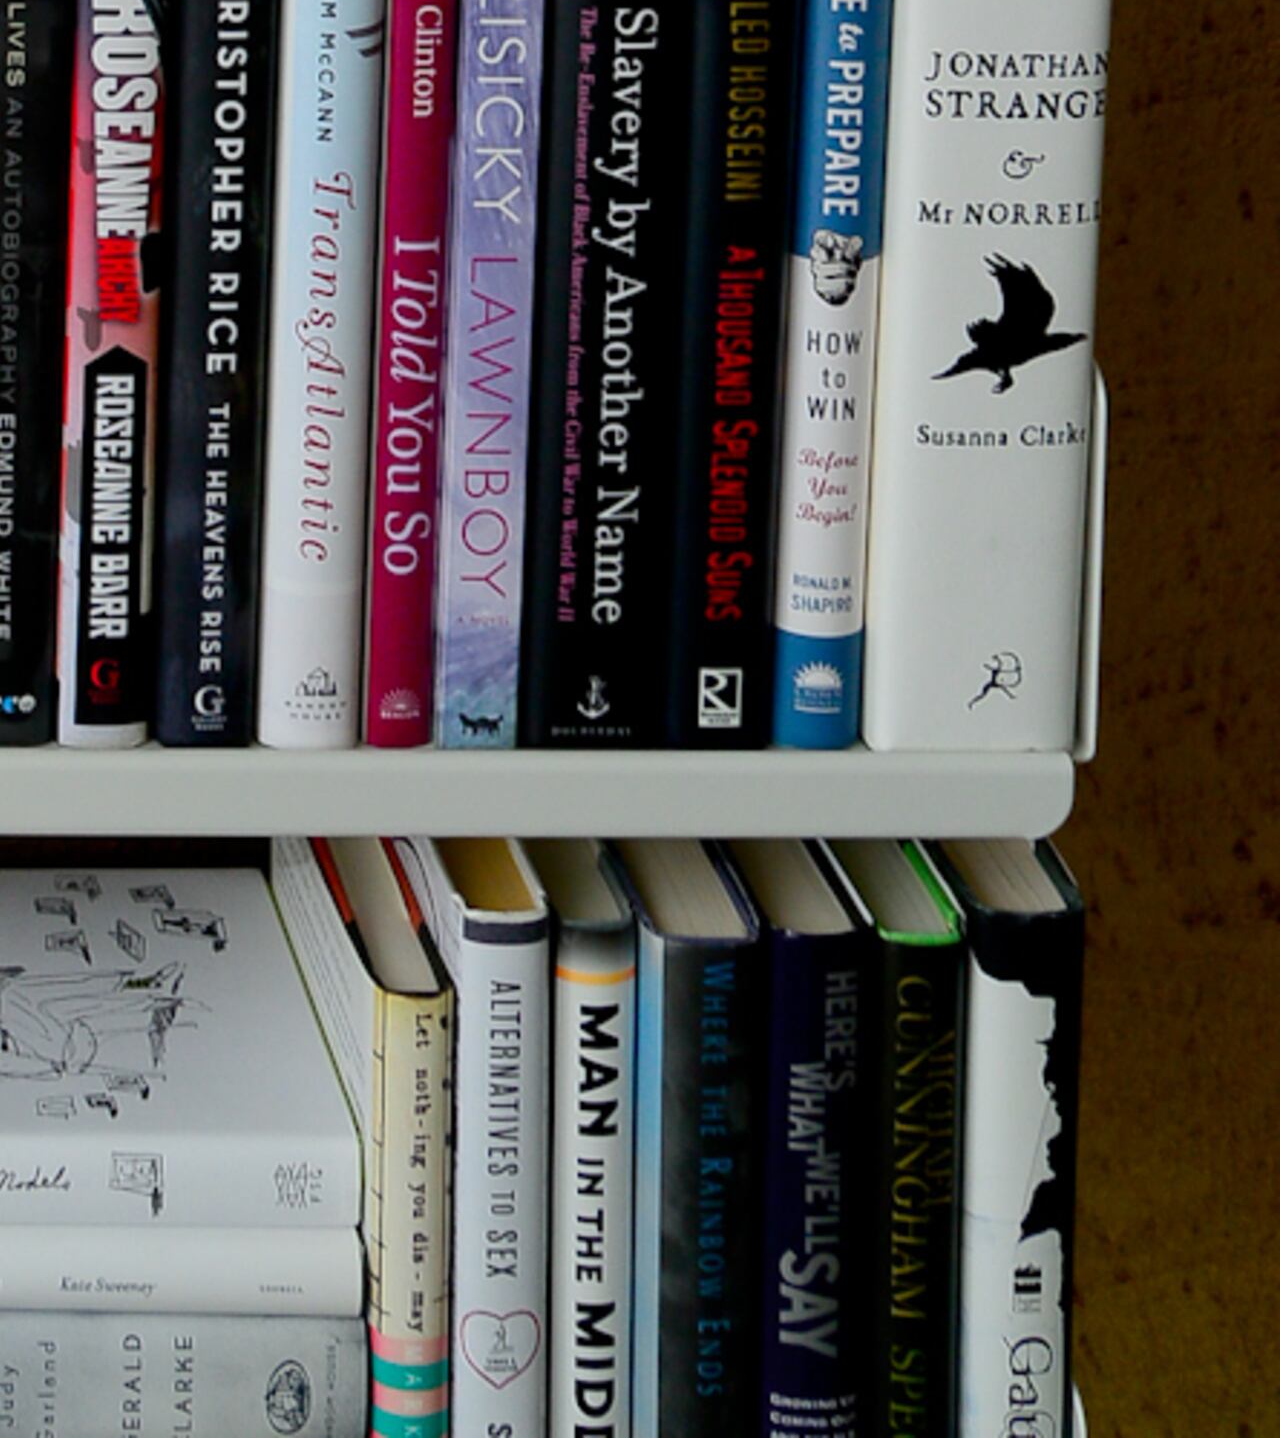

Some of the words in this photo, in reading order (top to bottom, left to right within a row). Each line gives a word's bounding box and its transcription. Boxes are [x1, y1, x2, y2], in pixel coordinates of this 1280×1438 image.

[412, 4, 443, 120] Clinton
[204, 273, 238, 376] RICE
[806, 329, 863, 356] HOW
[821, 367, 848, 388] to
[206, 404, 231, 456] THE
[457, 257, 520, 599] LAWNBOY
[806, 395, 857, 421] WIN
[201, 465, 228, 601] HEAVENS
[199, 610, 223, 673] RISE
[485, 979, 522, 1180] ALTERNATIVES
[490, 1188, 516, 1218] TO
[484, 1229, 518, 1280] SEX
